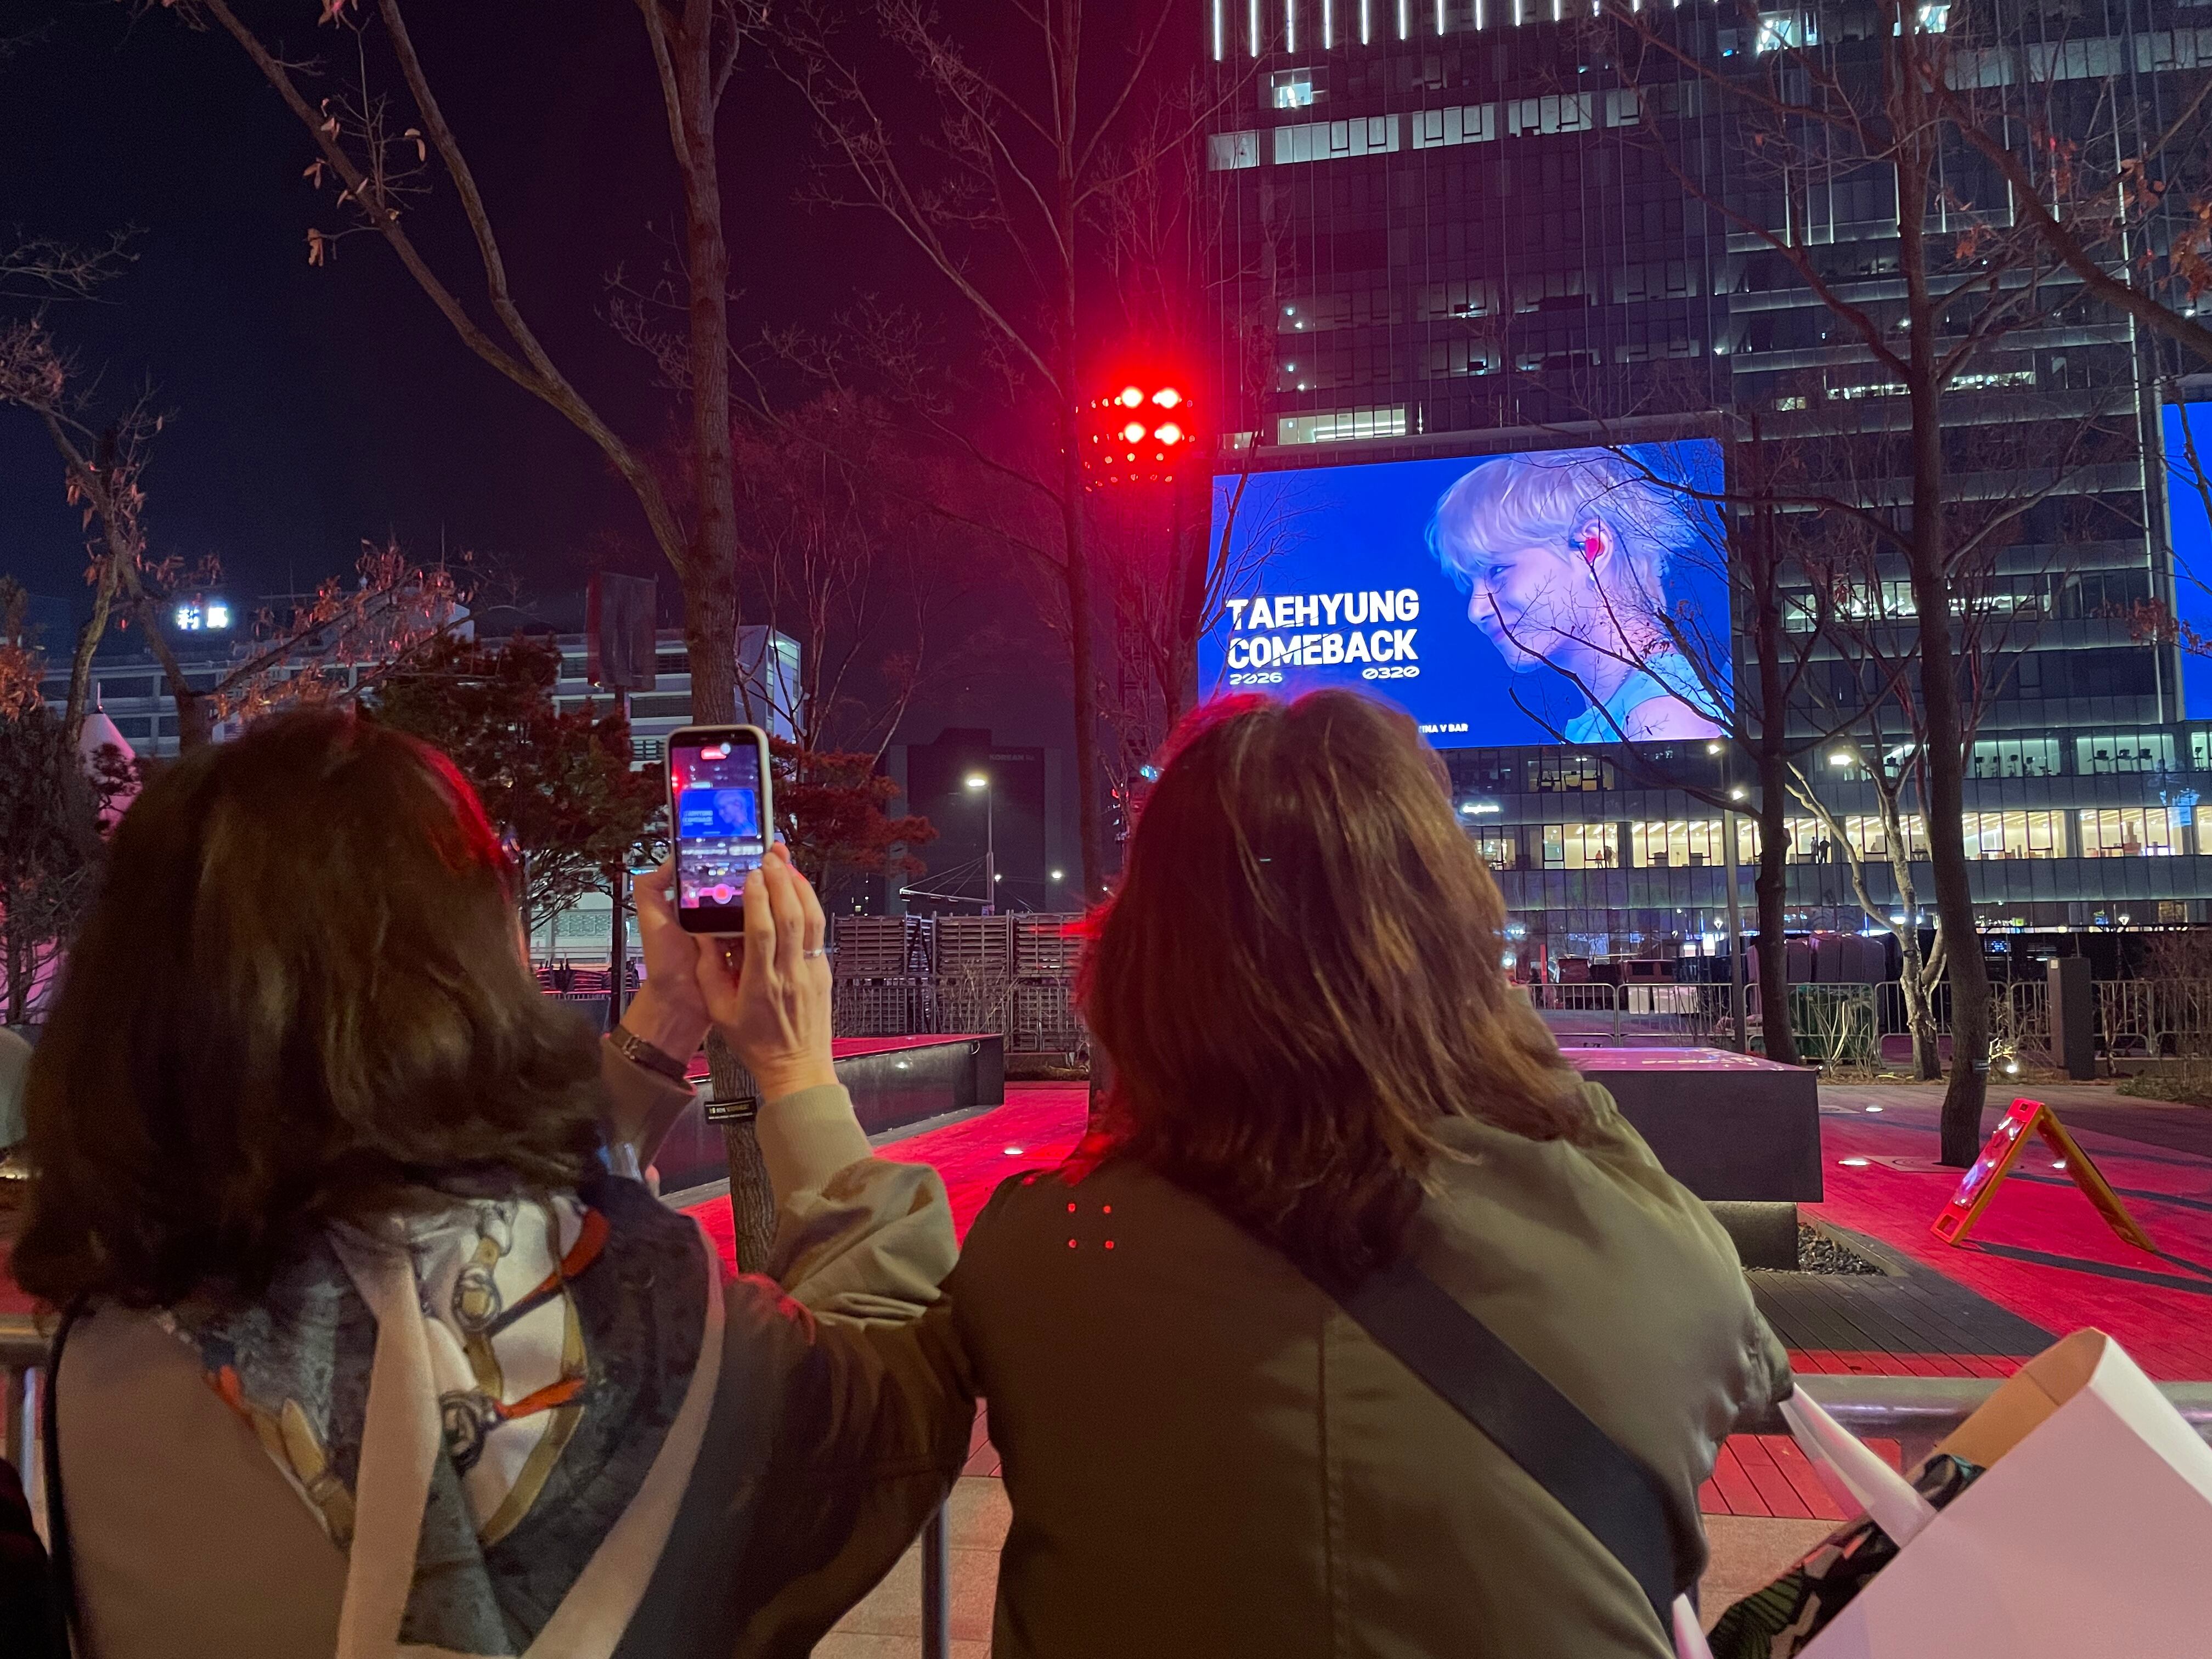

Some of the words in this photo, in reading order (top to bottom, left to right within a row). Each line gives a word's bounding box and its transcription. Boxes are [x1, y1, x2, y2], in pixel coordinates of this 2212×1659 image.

[1226, 588, 1420, 630] TAEHYUNG
[1227, 629, 1419, 669] COMEBACK
[1229, 672, 1283, 686] 2026
[1362, 665, 1420, 680] 0320
[1440, 724, 1447, 732] V
[1448, 723, 1469, 732] BAR
